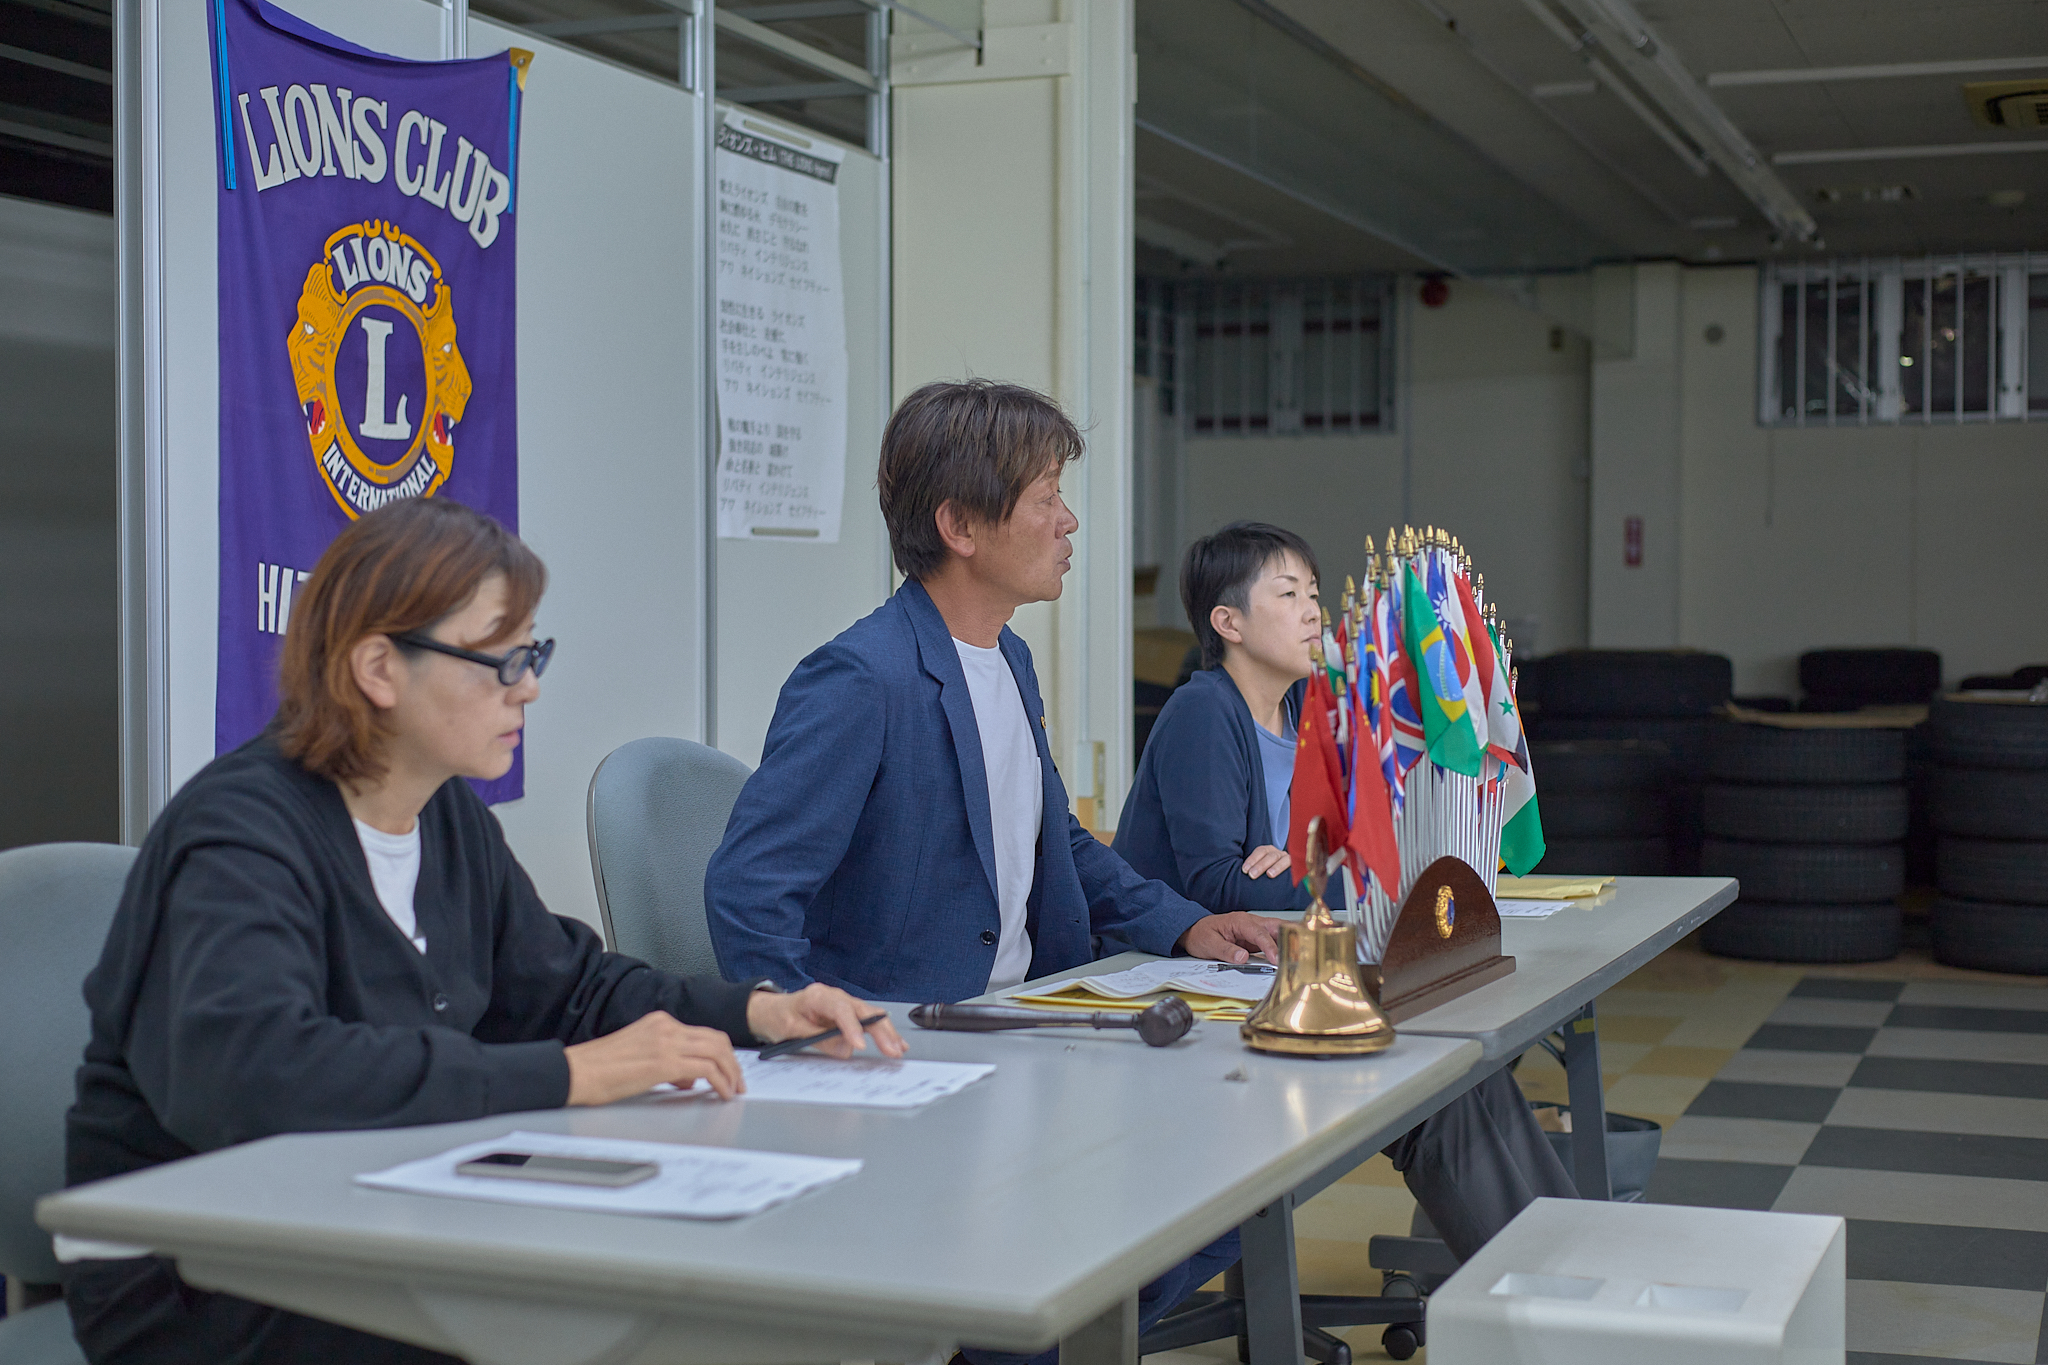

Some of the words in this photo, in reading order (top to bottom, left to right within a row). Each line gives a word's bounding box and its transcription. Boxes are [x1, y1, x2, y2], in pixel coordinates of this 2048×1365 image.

[238, 83, 388, 192] LIONS
[394, 110, 510, 249] CLUB
[332, 236, 432, 303] LIONS
[359, 316, 412, 440] L
[322, 442, 437, 512] INTERNATIONAL
